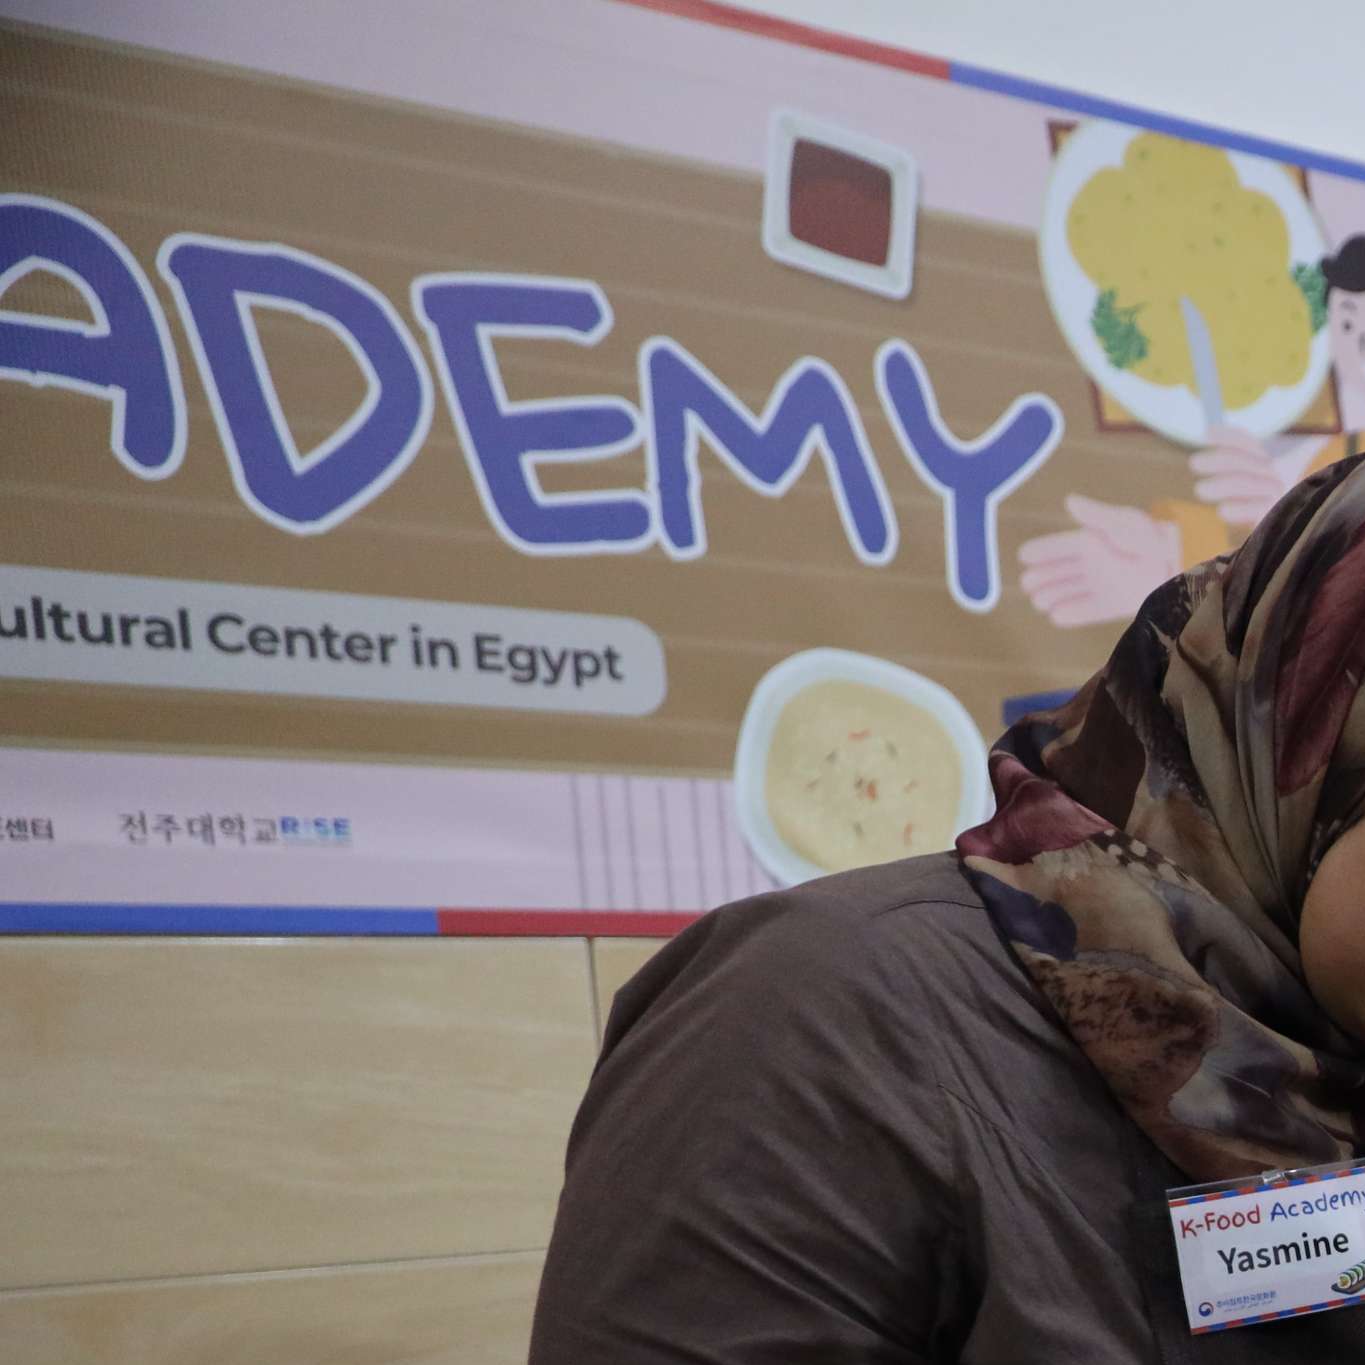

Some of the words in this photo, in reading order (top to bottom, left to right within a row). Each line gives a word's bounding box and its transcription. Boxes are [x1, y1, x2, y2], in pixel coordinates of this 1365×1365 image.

[0, 194, 1063, 611] ADEMY
[0, 594, 192, 651] ultural
[207, 611, 395, 666] Center
[410, 625, 458, 669] in
[474, 633, 623, 687] Egypt
[0, 816, 54, 842] 센터
[118, 810, 277, 846] 전주대학교
[1180, 1204, 1262, 1239] K-Food
[1217, 1232, 1349, 1274] Yasmine
